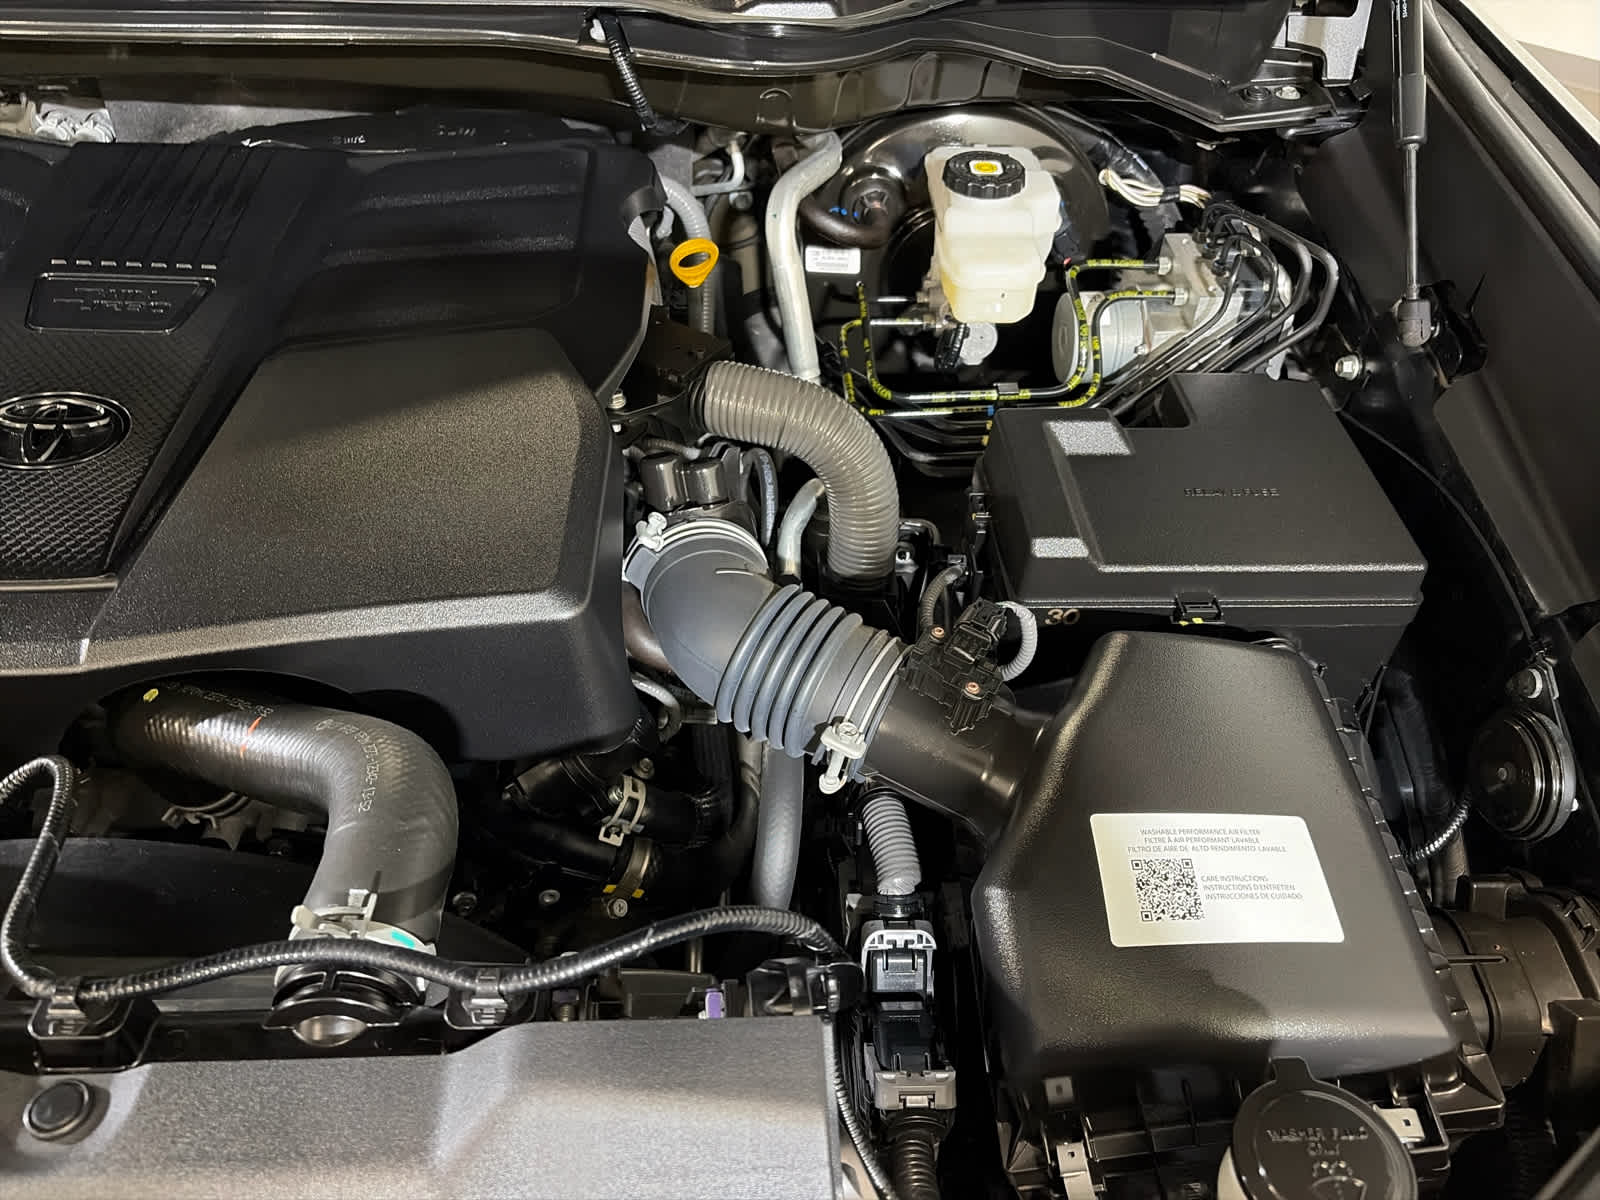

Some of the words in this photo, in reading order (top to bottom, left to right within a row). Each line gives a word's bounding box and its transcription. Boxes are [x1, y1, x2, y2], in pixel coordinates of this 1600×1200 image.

[1045, 608, 1080, 625] 30
[1140, 828, 1177, 836] WASHABLE
[1178, 828, 1227, 836] PERFORMANCE
[1191, 845, 1210, 853] ALTO
[1201, 874, 1219, 883] CARE
[1220, 874, 1269, 883] INSTRUCTIONS
[1203, 883, 1253, 892] INSTRUCTIONS
